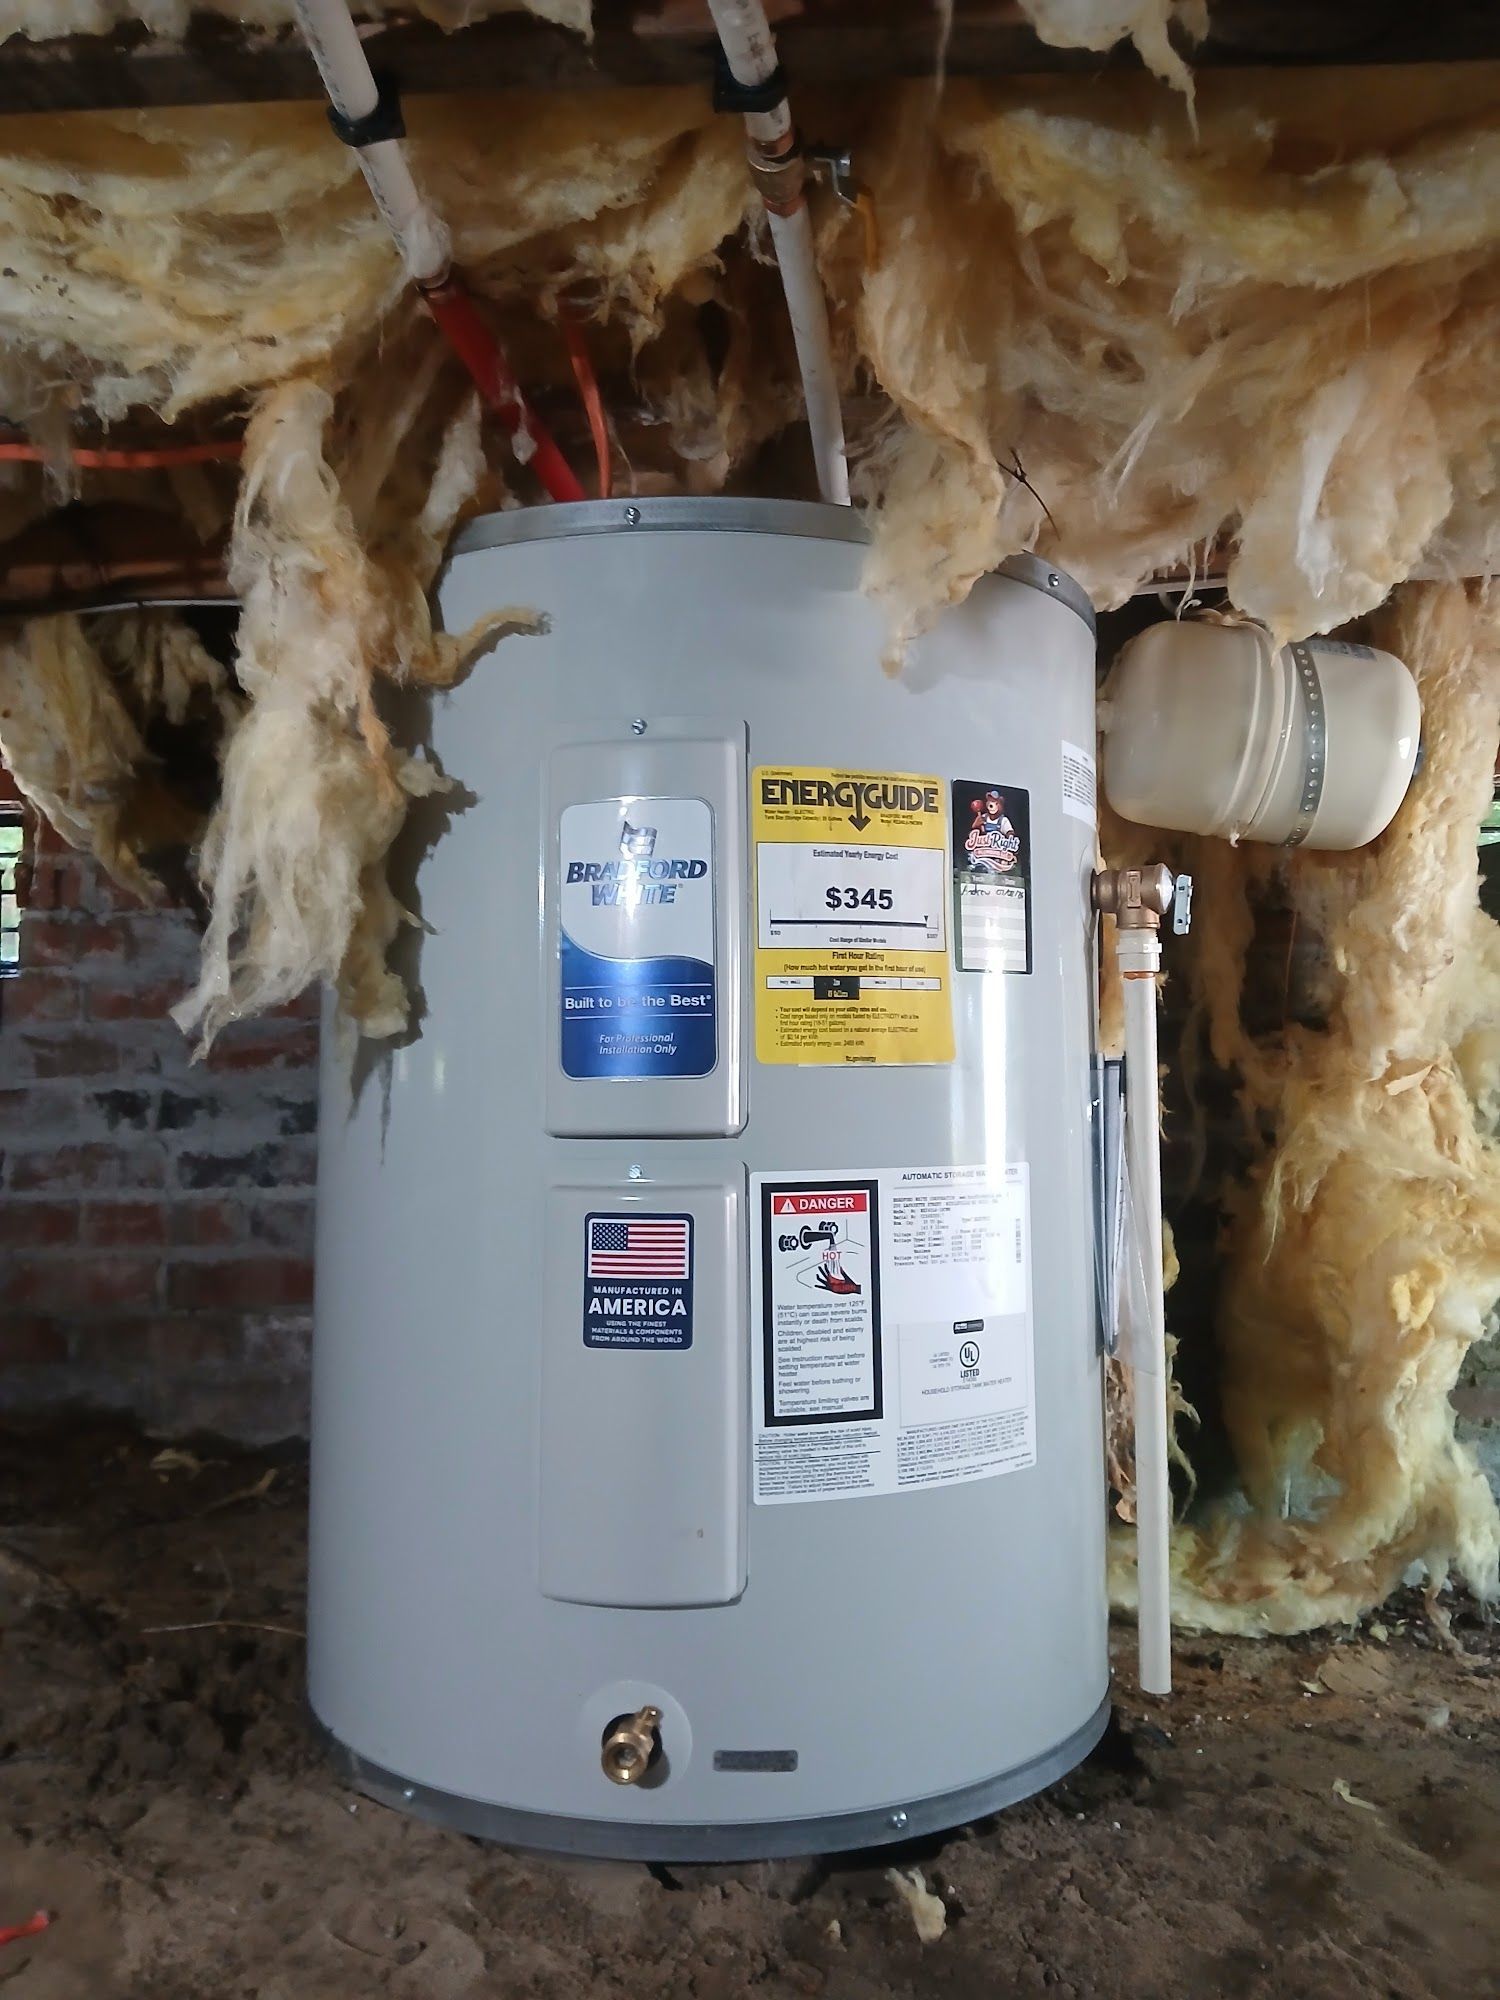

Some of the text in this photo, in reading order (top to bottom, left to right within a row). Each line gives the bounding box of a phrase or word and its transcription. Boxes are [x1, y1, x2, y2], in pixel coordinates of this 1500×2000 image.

[762, 779, 938, 814] ENERGYGUIDE
[990, 831, 1020, 852] Right
[813, 849, 899, 861] Estimated Yearly Energy Cost
[826, 886, 894, 912] $345
[832, 951, 884, 961] First Hour Rating
[784, 964, 799, 972] (How
[846, 965, 857, 973] you
[859, 965, 867, 973] get
[565, 998, 595, 1010] Built
[599, 998, 613, 1008] to
[642, 996, 666, 1007] the
[600, 1035, 614, 1044] For
[600, 1044, 677, 1055] Installation Only
[902, 1172, 942, 1181] AUTOMATIC
[800, 1198, 855, 1210] DANGER
[823, 1252, 841, 1260] HOT
[594, 1286, 682, 1295] MANUFACTURED IN
[588, 1297, 687, 1316] AMERICA
[797, 1303, 832, 1311] temperature
[964, 1347, 976, 1362] UL
[960, 1369, 979, 1378] LISTED
